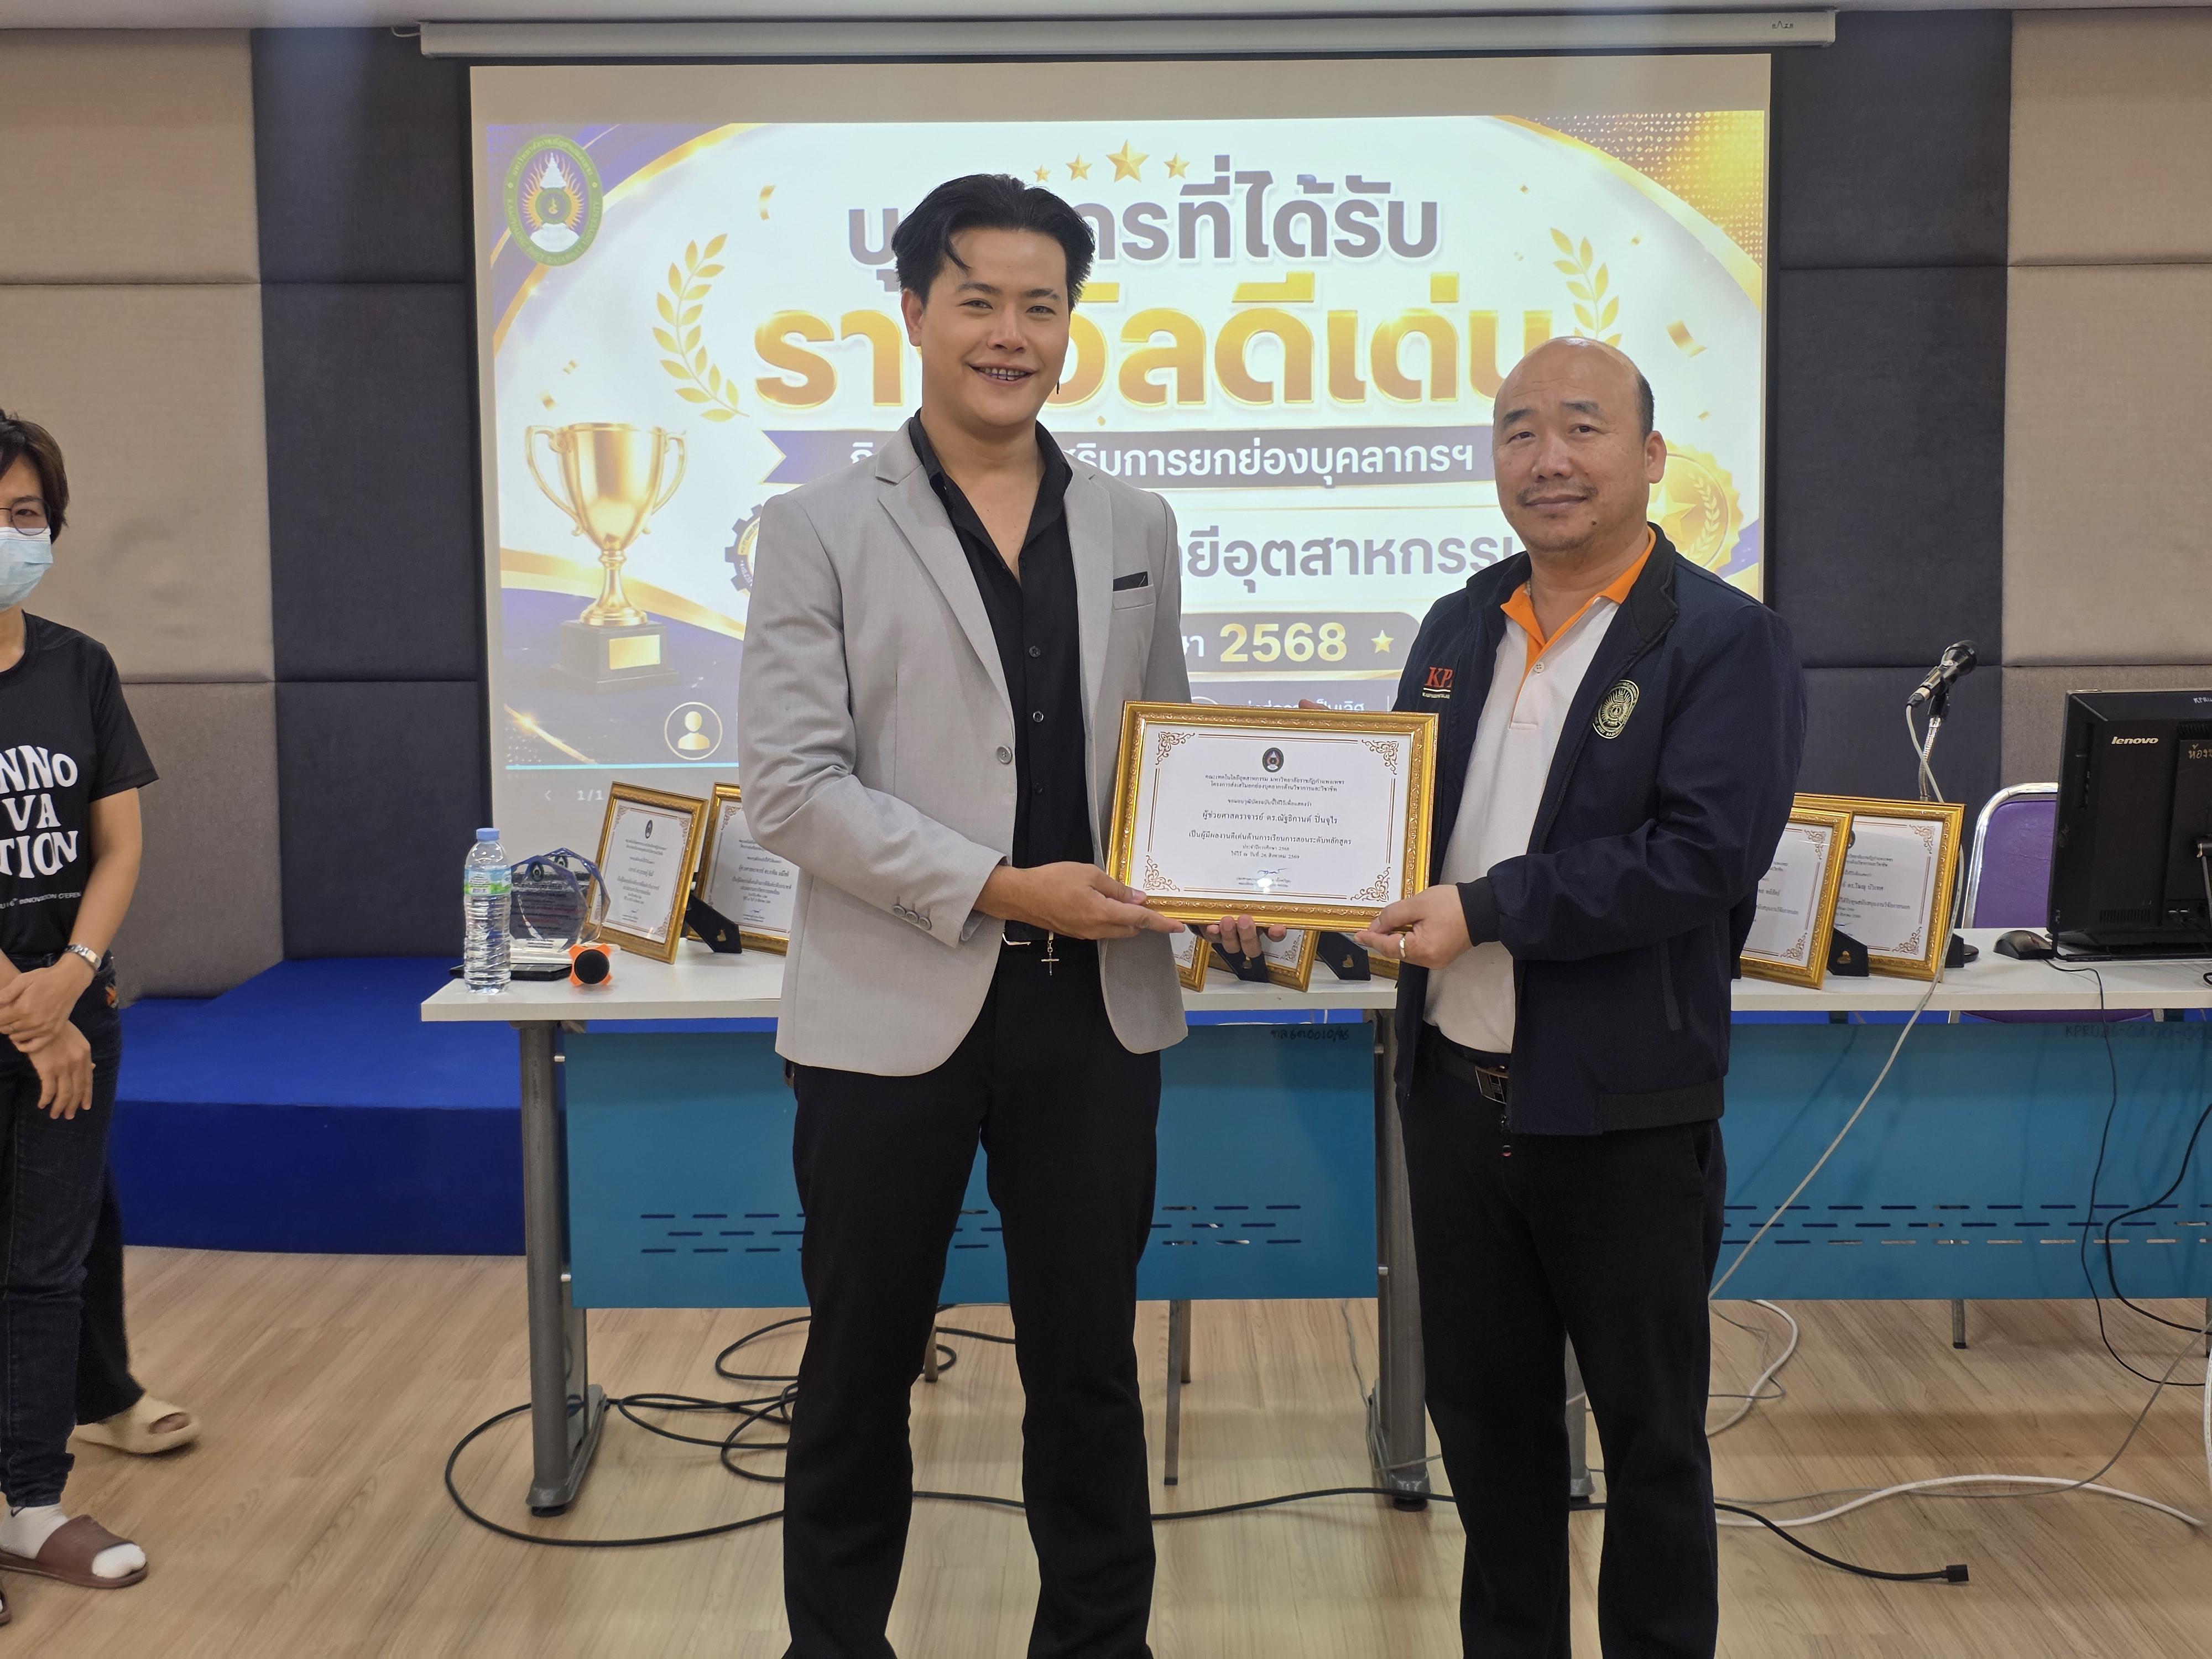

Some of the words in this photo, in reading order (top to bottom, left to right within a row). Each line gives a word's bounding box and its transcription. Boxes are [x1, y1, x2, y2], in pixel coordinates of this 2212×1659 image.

[1219, 622, 1348, 662] 2568
[1423, 666, 1453, 688] KP
[2111, 736, 2159, 745] lenovo
[577, 790, 603, 801] 1/1
[2, 793, 61, 832] VA
[1202, 810, 1264, 821] ผู้ช่วยศาสตราจารย์
